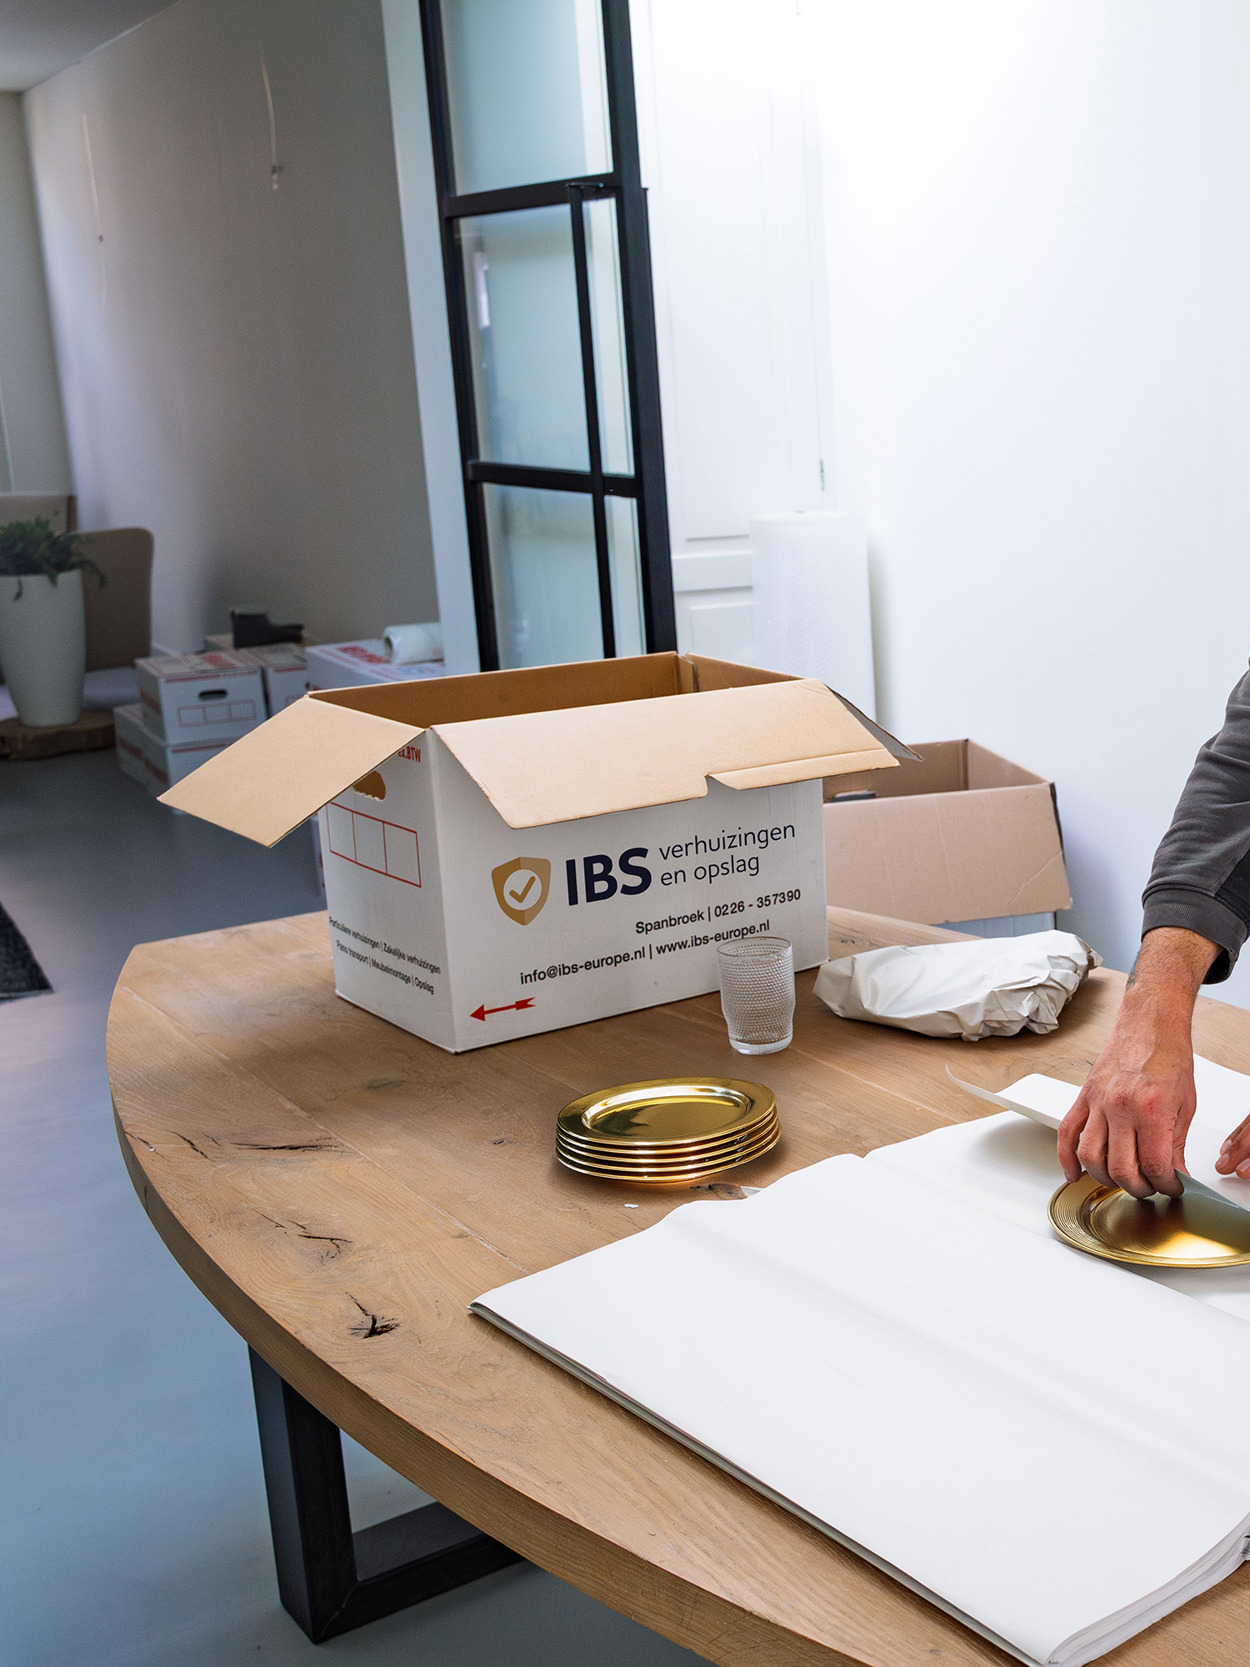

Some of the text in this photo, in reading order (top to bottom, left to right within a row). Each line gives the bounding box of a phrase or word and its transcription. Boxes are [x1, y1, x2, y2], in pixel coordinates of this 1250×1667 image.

[657, 824, 796, 861] verhuizingen
[565, 847, 653, 907] IBS
[660, 855, 760, 886] en opslag
[634, 909, 705, 935] Spanbroek
[714, 900, 746, 918] 0226
[756, 888, 801, 909] 357390
[519, 946, 646, 985] info@ibs-europe.nl
[655, 919, 771, 956] www.ibs-europe.nl
